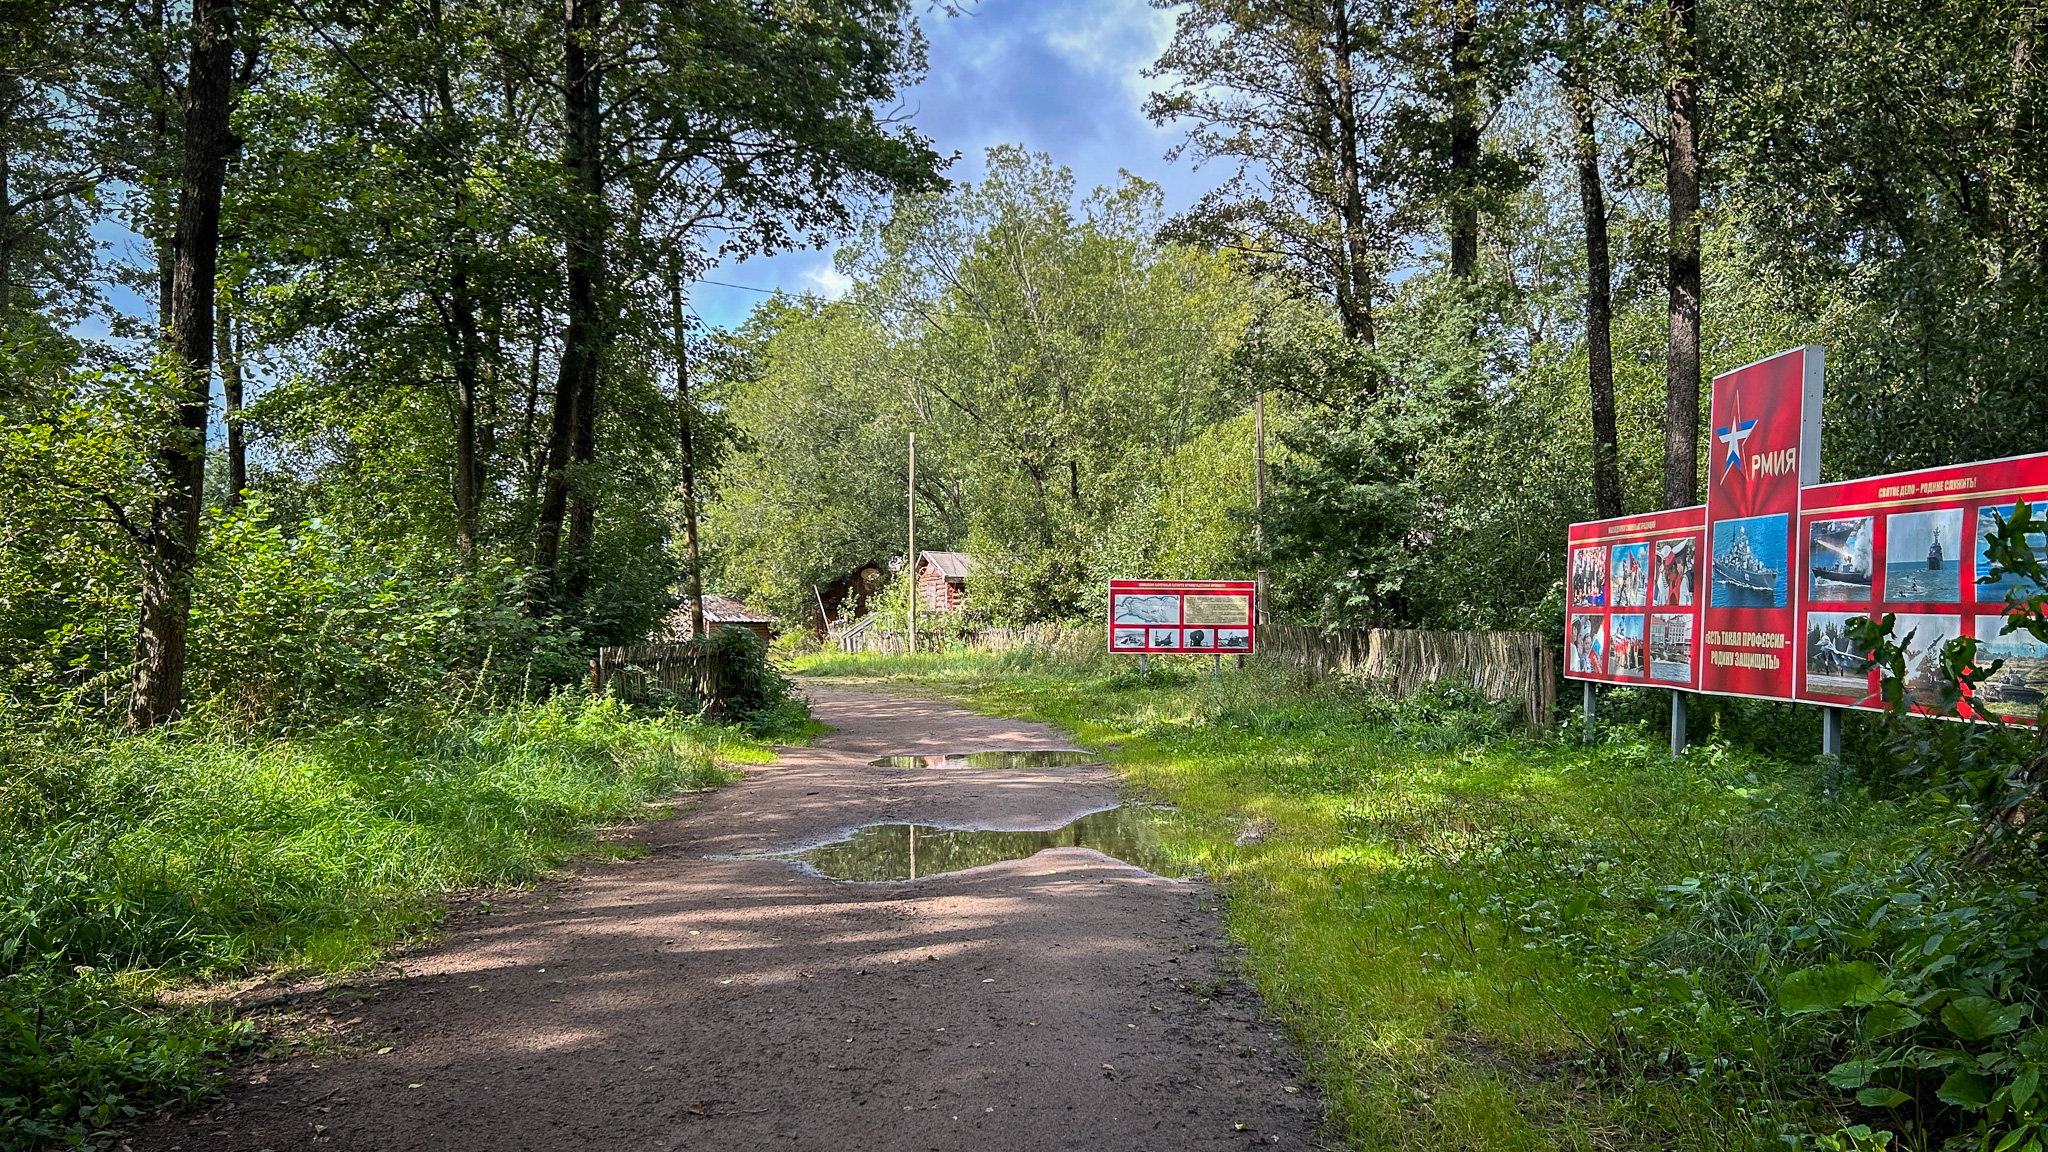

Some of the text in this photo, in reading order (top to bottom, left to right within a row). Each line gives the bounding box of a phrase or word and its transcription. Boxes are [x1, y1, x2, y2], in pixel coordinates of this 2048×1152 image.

[1878, 486, 1899, 498] СВЯТОЕ
[1899, 484, 1915, 498] ДЕЛО
[1920, 481, 1943, 494] РОДИНЕ
[1944, 477, 1977, 491] СЛУЖИТЬ!
[1721, 631, 1741, 646] ТАКАЯ
[1742, 632, 1785, 648] ПРОФЕССИЯ
[1710, 650, 1734, 667] РОДИНУ
